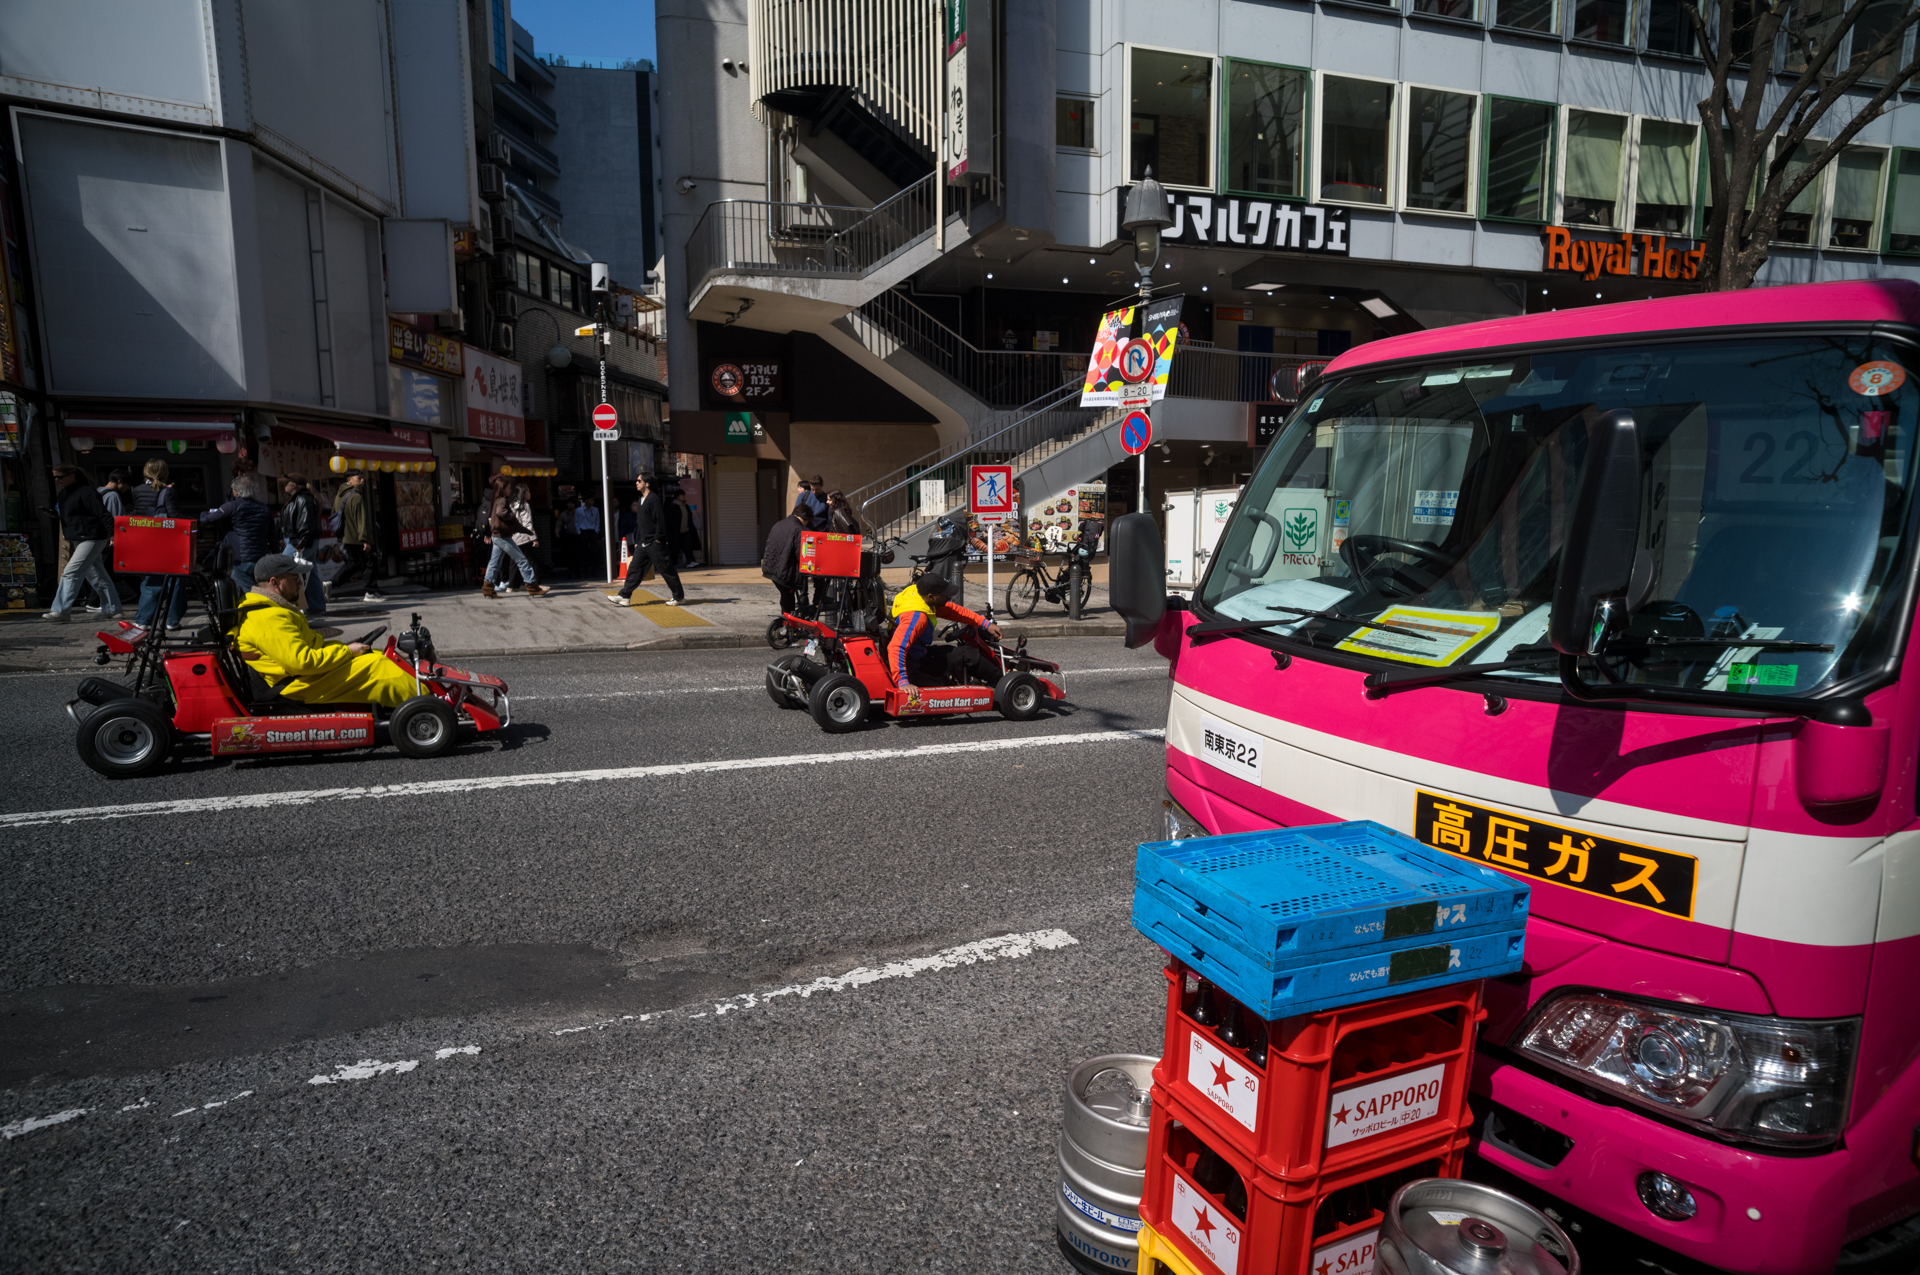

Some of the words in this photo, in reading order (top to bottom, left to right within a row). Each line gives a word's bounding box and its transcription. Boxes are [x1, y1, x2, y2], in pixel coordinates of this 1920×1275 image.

[950, 83, 964, 160] ねぎし
[1127, 194, 1346, 251] ンマルクカフェ
[1546, 226, 1633, 281] Royal
[1642, 235, 1706, 280] Hos
[393, 326, 423, 353] 出会い
[423, 343, 444, 367] カフェ
[742, 364, 778, 375] サンマルク
[750, 375, 771, 385] カフェ
[488, 367, 519, 408] 鳥世界
[745, 386, 762, 396] 2F
[479, 413, 516, 439] 焼き鳥酒場
[402, 529, 435, 549] 焼き鳥酒場
[1283, 553, 1316, 566] PRECO
[928, 698, 954, 708] Street
[954, 697, 971, 707] Kart
[266, 730, 307, 743] Street
[308, 728, 336, 741] Kart
[337, 728, 367, 740] .com
[1204, 729, 1257, 769] 南東京22
[1431, 802, 1666, 904] 高圧ガス
[1194, 1039, 1202, 1052] 中
[1244, 1075, 1256, 1093] 20
[1206, 1087, 1234, 1114] SAPPORO
[1354, 1079, 1440, 1122] SAPPORO
[1352, 1116, 1399, 1138] サッポロビール
[1177, 1182, 1185, 1194] 中
[1064, 1184, 1105, 1221] サントリー生ビール
[1189, 1231, 1216, 1261] SAPPORO
[1225, 1227, 1237, 1244] 20
